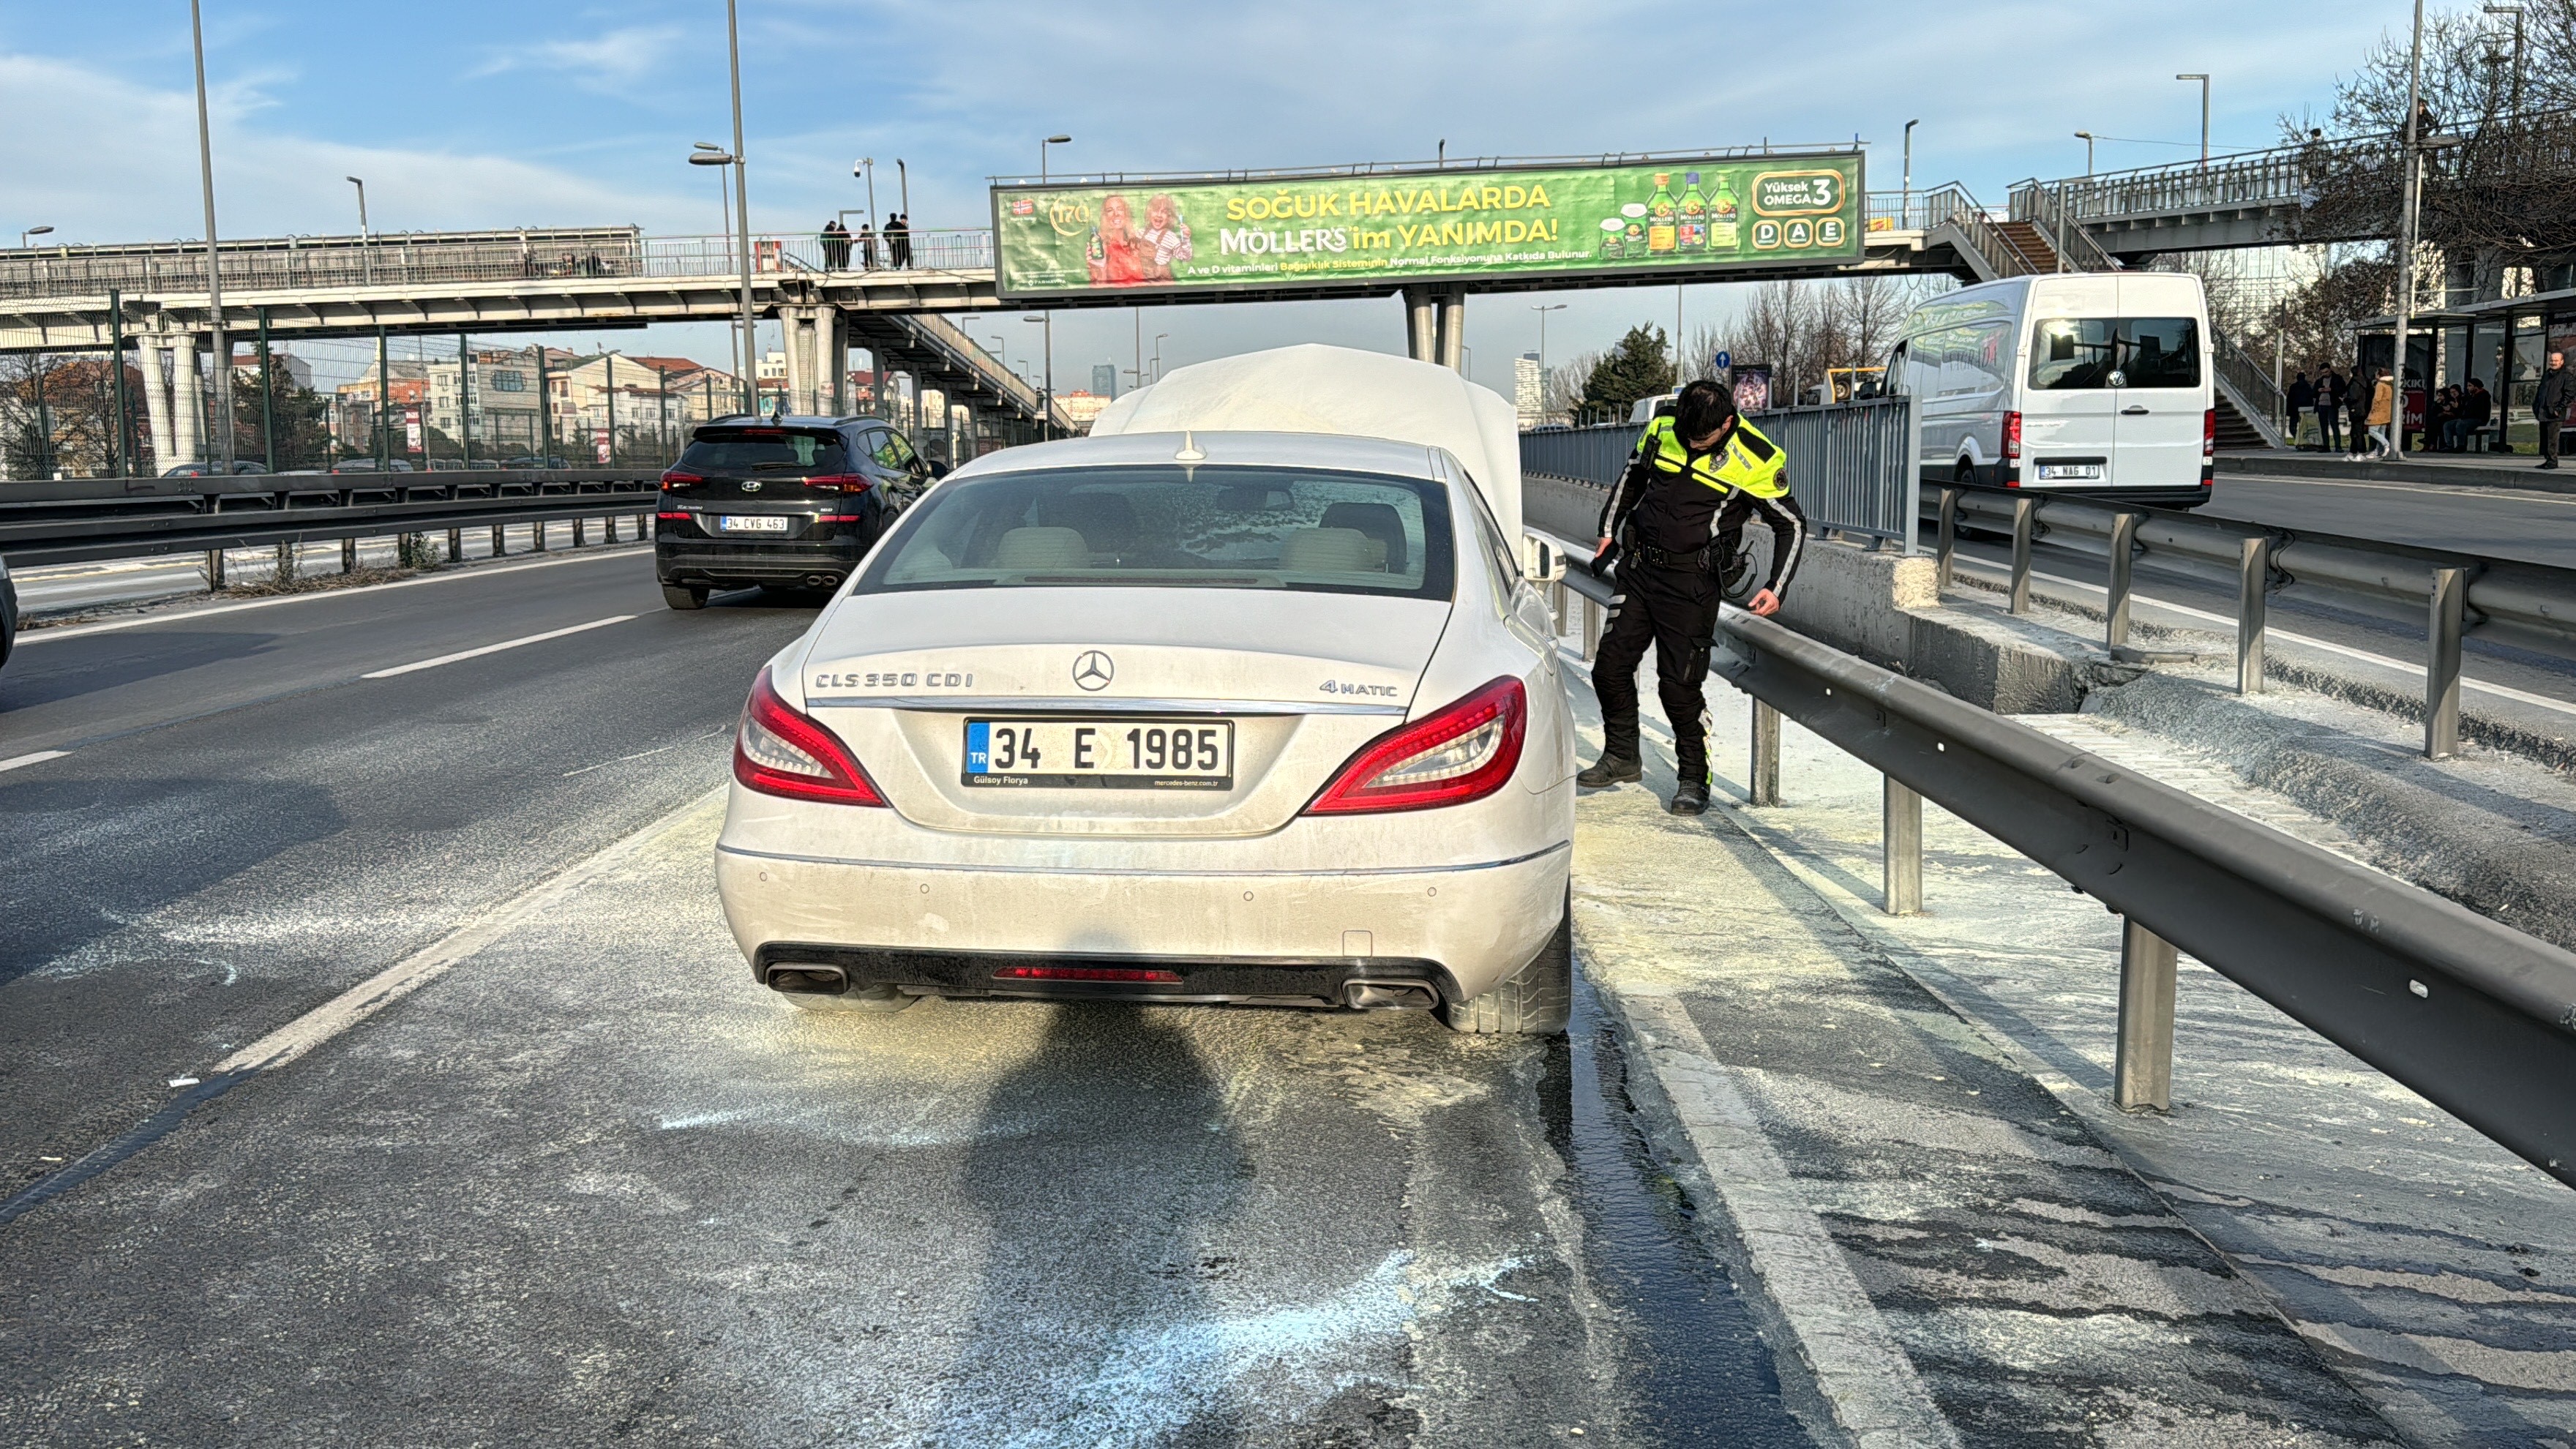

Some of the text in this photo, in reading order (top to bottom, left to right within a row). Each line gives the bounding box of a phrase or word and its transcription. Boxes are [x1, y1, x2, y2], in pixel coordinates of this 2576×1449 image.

[1764, 181, 1808, 193] Yüksek
[1764, 179, 1831, 206] OMEGA 3
[1227, 184, 1551, 220] SOĞUK HAVALARDA
[1057, 205, 1090, 223] 170
[1397, 218, 1558, 247] YANIMDA!
[1760, 222, 1837, 240] D A E
[1188, 266, 1196, 275] A
[1197, 266, 1210, 274] ve
[1211, 265, 1220, 274] D
[1221, 262, 1278, 274] vitaminleri
[1332, 258, 1388, 269] Sisteminin
[1390, 255, 1429, 266] Normal
[1505, 251, 1546, 261] Katkıda
[2045, 466, 2097, 476] 34 NAG 01
[727, 518, 738, 528] 34
[744, 518, 762, 529] CVG
[767, 519, 785, 529] 463
[816, 673, 973, 687] CLS 350 CDI
[995, 727, 1218, 771] 34 E 1985
[970, 752, 986, 765] TR
[973, 776, 1028, 786] Gülsoy Florya
[1154, 779, 1218, 787] mercedes-benz.com.tr
